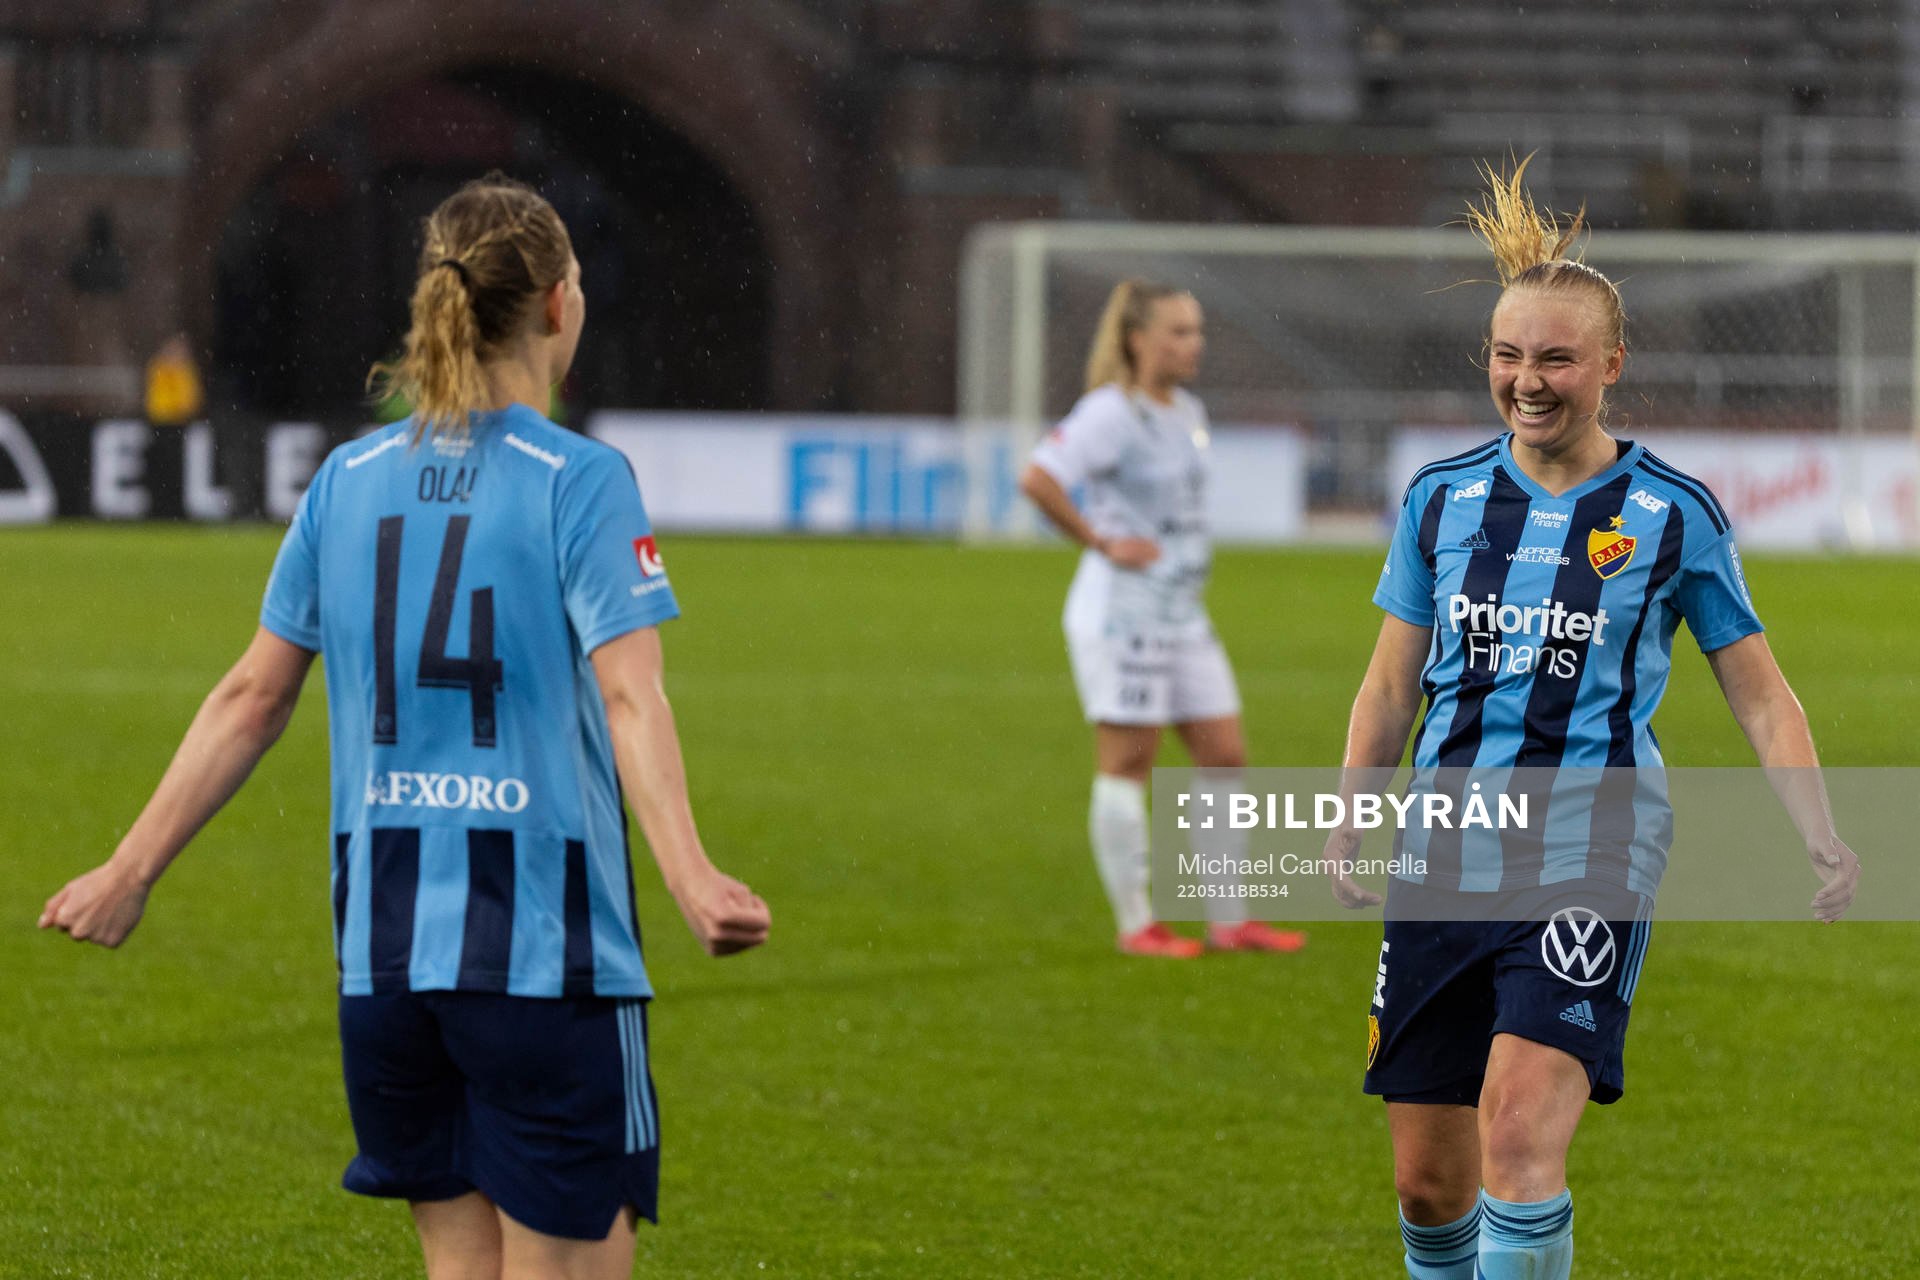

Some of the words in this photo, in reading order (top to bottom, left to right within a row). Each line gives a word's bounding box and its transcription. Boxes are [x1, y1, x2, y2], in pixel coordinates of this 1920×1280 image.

[91, 419, 384, 518] ELE
[1453, 480, 1488, 502] ABT
[1628, 489, 1669, 514] ABT
[1530, 510, 1569, 522] Prioritet
[1533, 519, 1561, 529] Finans
[1505, 553, 1571, 566] WELLNESS
[1517, 546, 1561, 556] NORDIC
[373, 515, 504, 747] 14
[1449, 593, 1610, 646] Prioritet
[1467, 632, 1577, 679] Finans
[1548, 909, 1615, 980] VW
[1559, 1011, 1598, 1033] adidas
